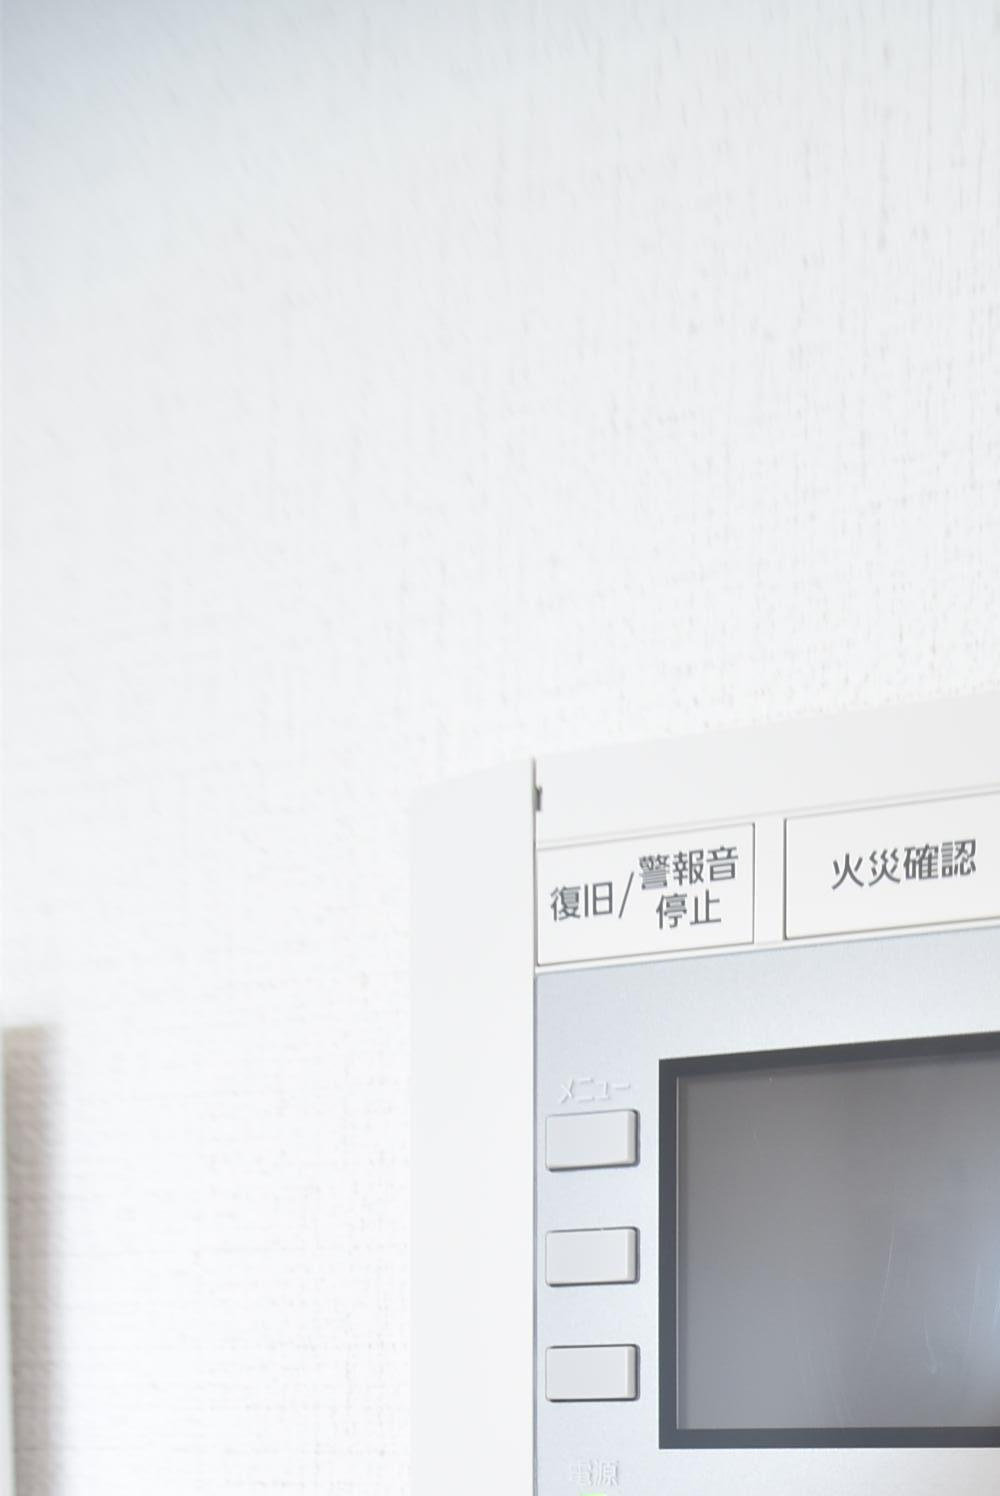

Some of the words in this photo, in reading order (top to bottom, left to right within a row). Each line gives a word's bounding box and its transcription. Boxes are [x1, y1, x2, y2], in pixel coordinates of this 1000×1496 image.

[831, 838, 977, 890] 火災確認
[655, 889, 722, 930] 停止
[558, 1077, 632, 1105] メニュー
